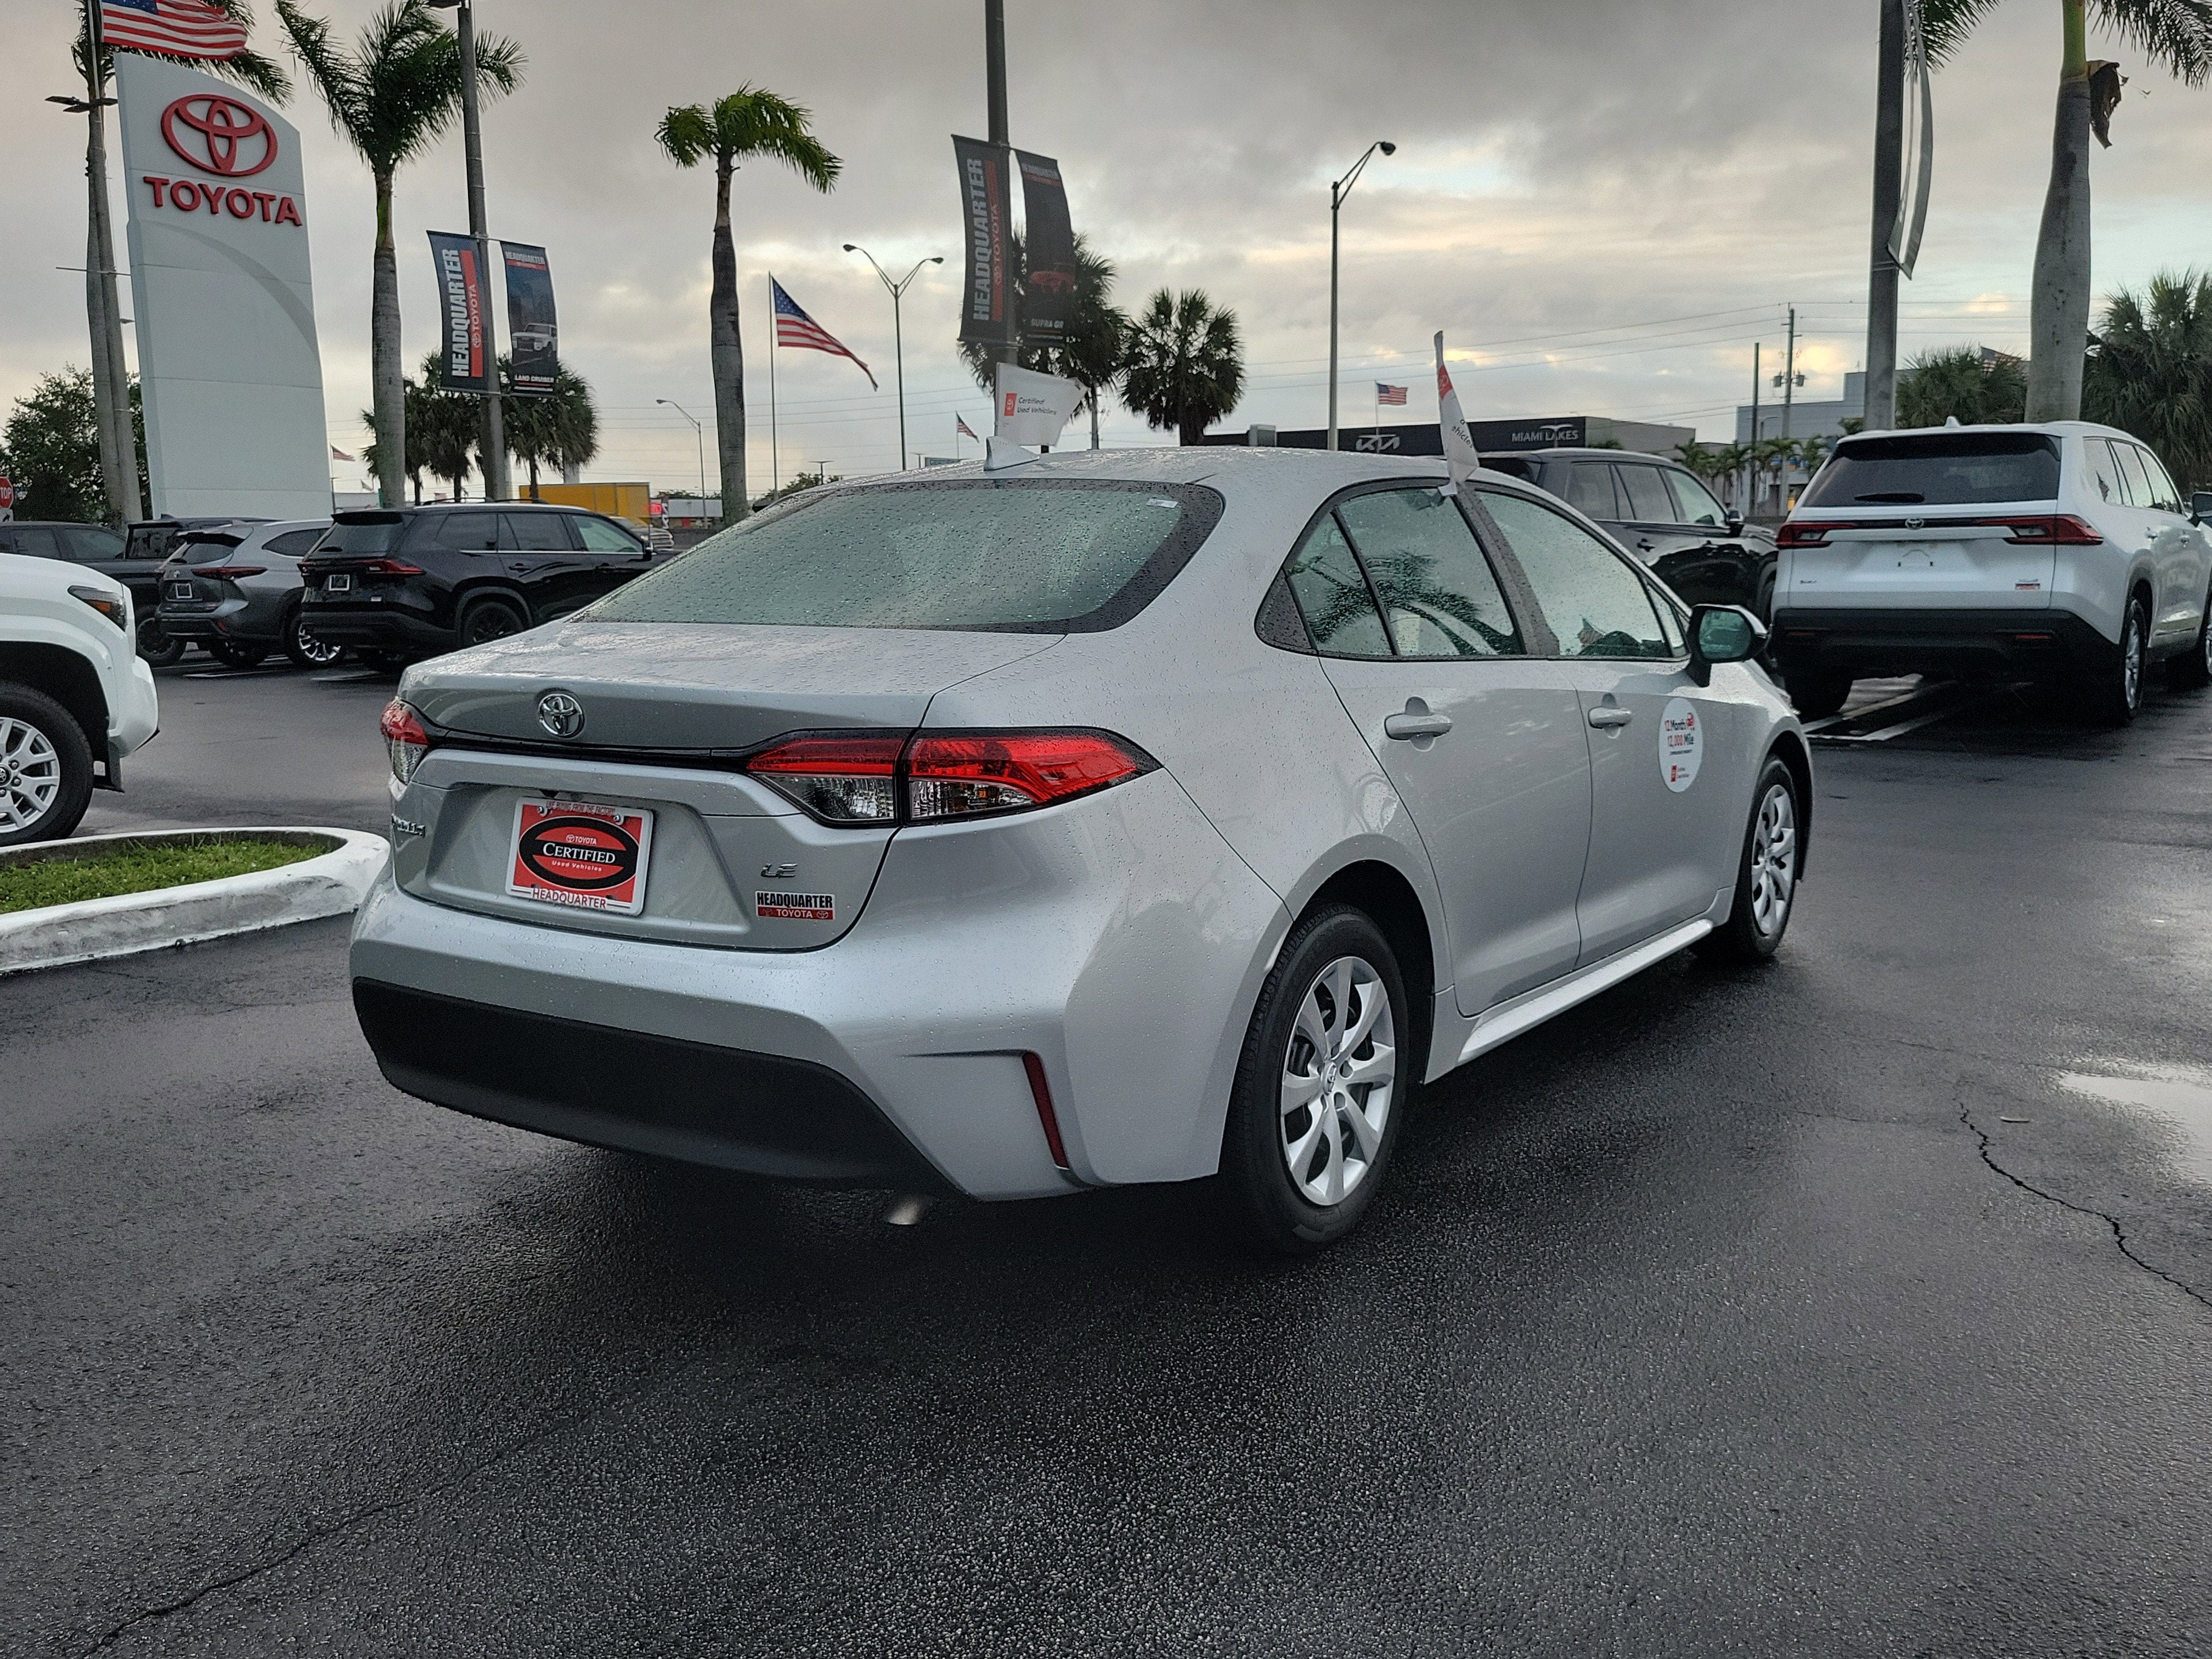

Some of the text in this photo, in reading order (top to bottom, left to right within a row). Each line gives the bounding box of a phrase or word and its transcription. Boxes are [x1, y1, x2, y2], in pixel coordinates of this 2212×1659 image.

[143, 176, 302, 226] TOYOTA
[967, 158, 991, 321] HEADQUARTER
[442, 249, 470, 377] HEADQUARTER
[469, 284, 482, 332] TOYOTA
[1031, 407, 1057, 415] Vehicles
[1451, 425, 1474, 449] ehicles
[1511, 430, 1579, 442] MIAMI LAKES
[0, 487, 11, 499] TOP
[575, 836, 597, 845] TOYOTA
[543, 842, 616, 864] CERTIFIED
[552, 860, 602, 872] Used Vehicles
[761, 863, 798, 878] LE
[532, 888, 606, 909] HEADQUARTER
[757, 892, 833, 909] HEADQUARTER
[776, 909, 813, 918] TOYOTA
